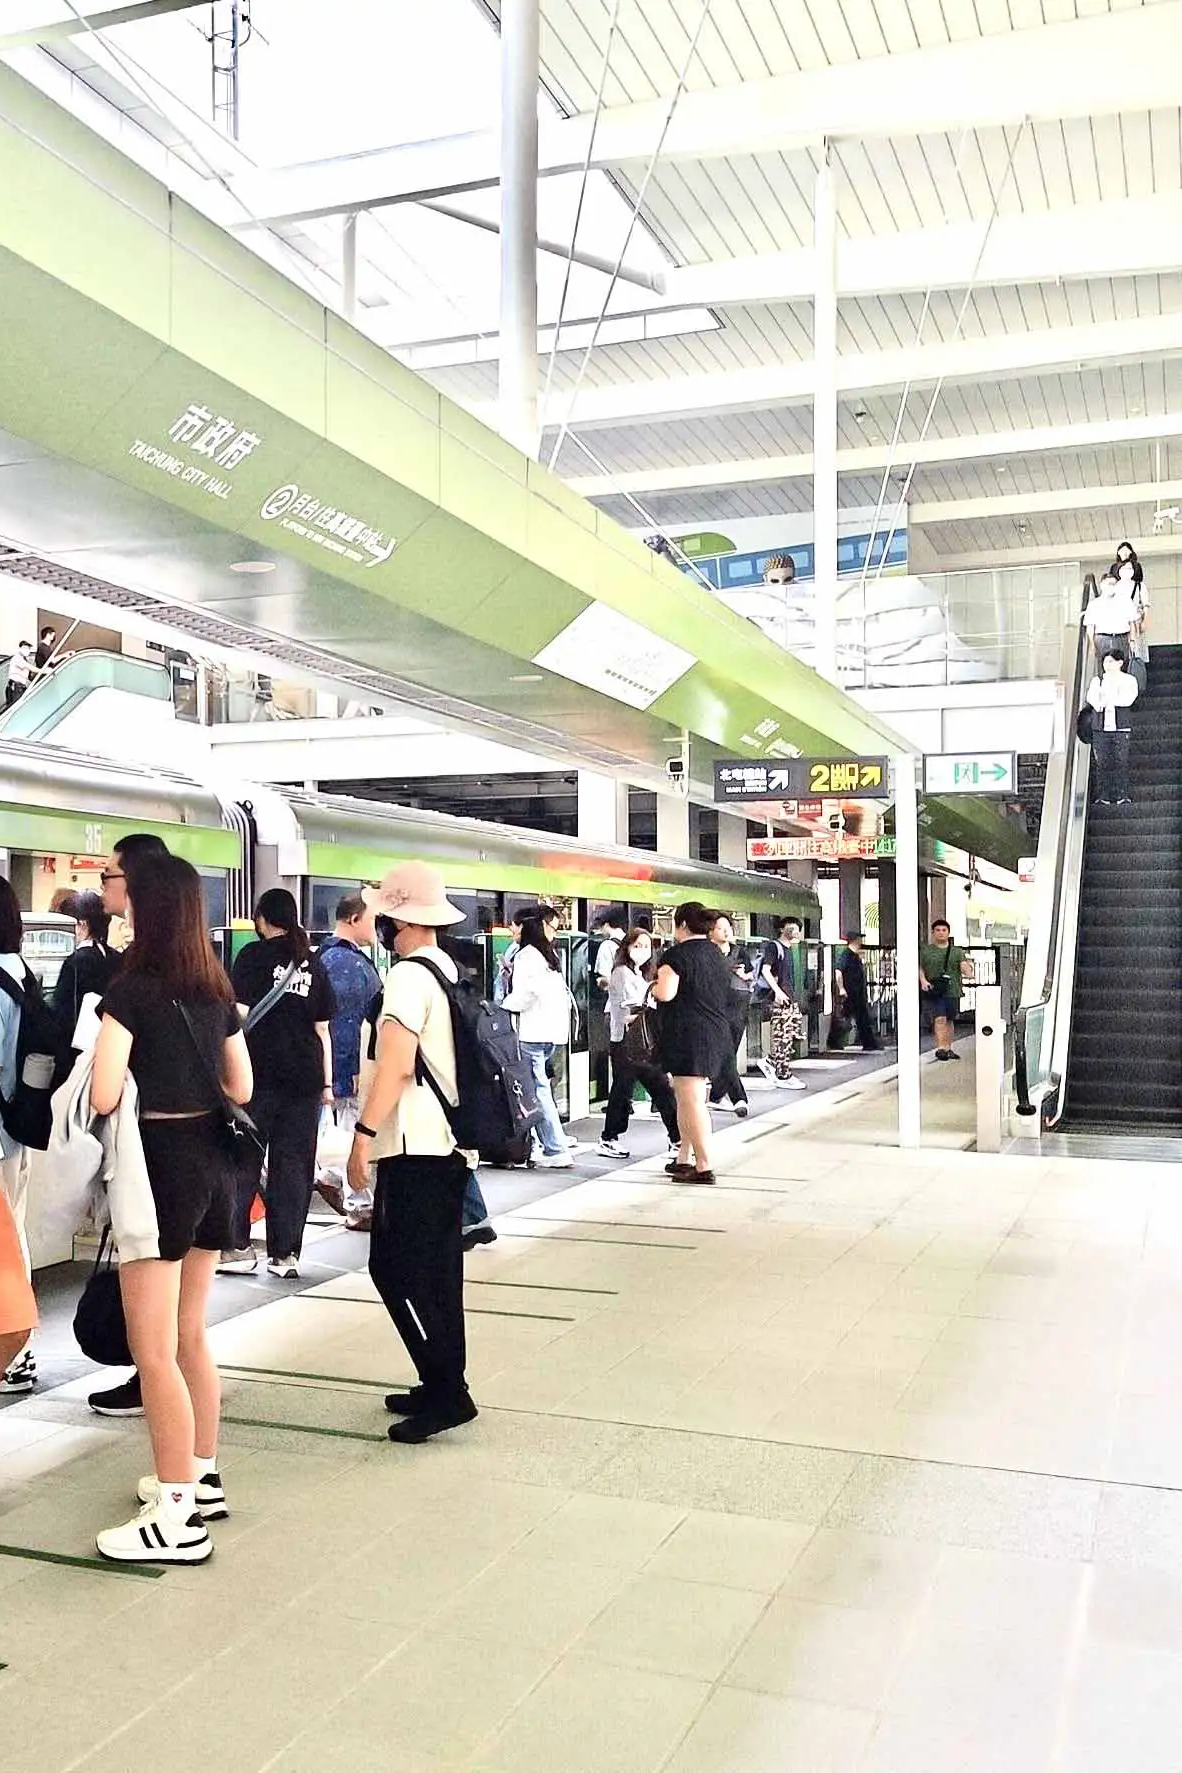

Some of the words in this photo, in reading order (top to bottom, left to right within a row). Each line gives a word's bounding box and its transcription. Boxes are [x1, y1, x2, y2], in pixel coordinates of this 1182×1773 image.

[169, 403, 261, 471] 市政府
[128, 440, 182, 475] TAICHUNG
[181, 463, 206, 487] CITY
[203, 475, 234, 499] HALL
[810, 764, 830, 792] 2
